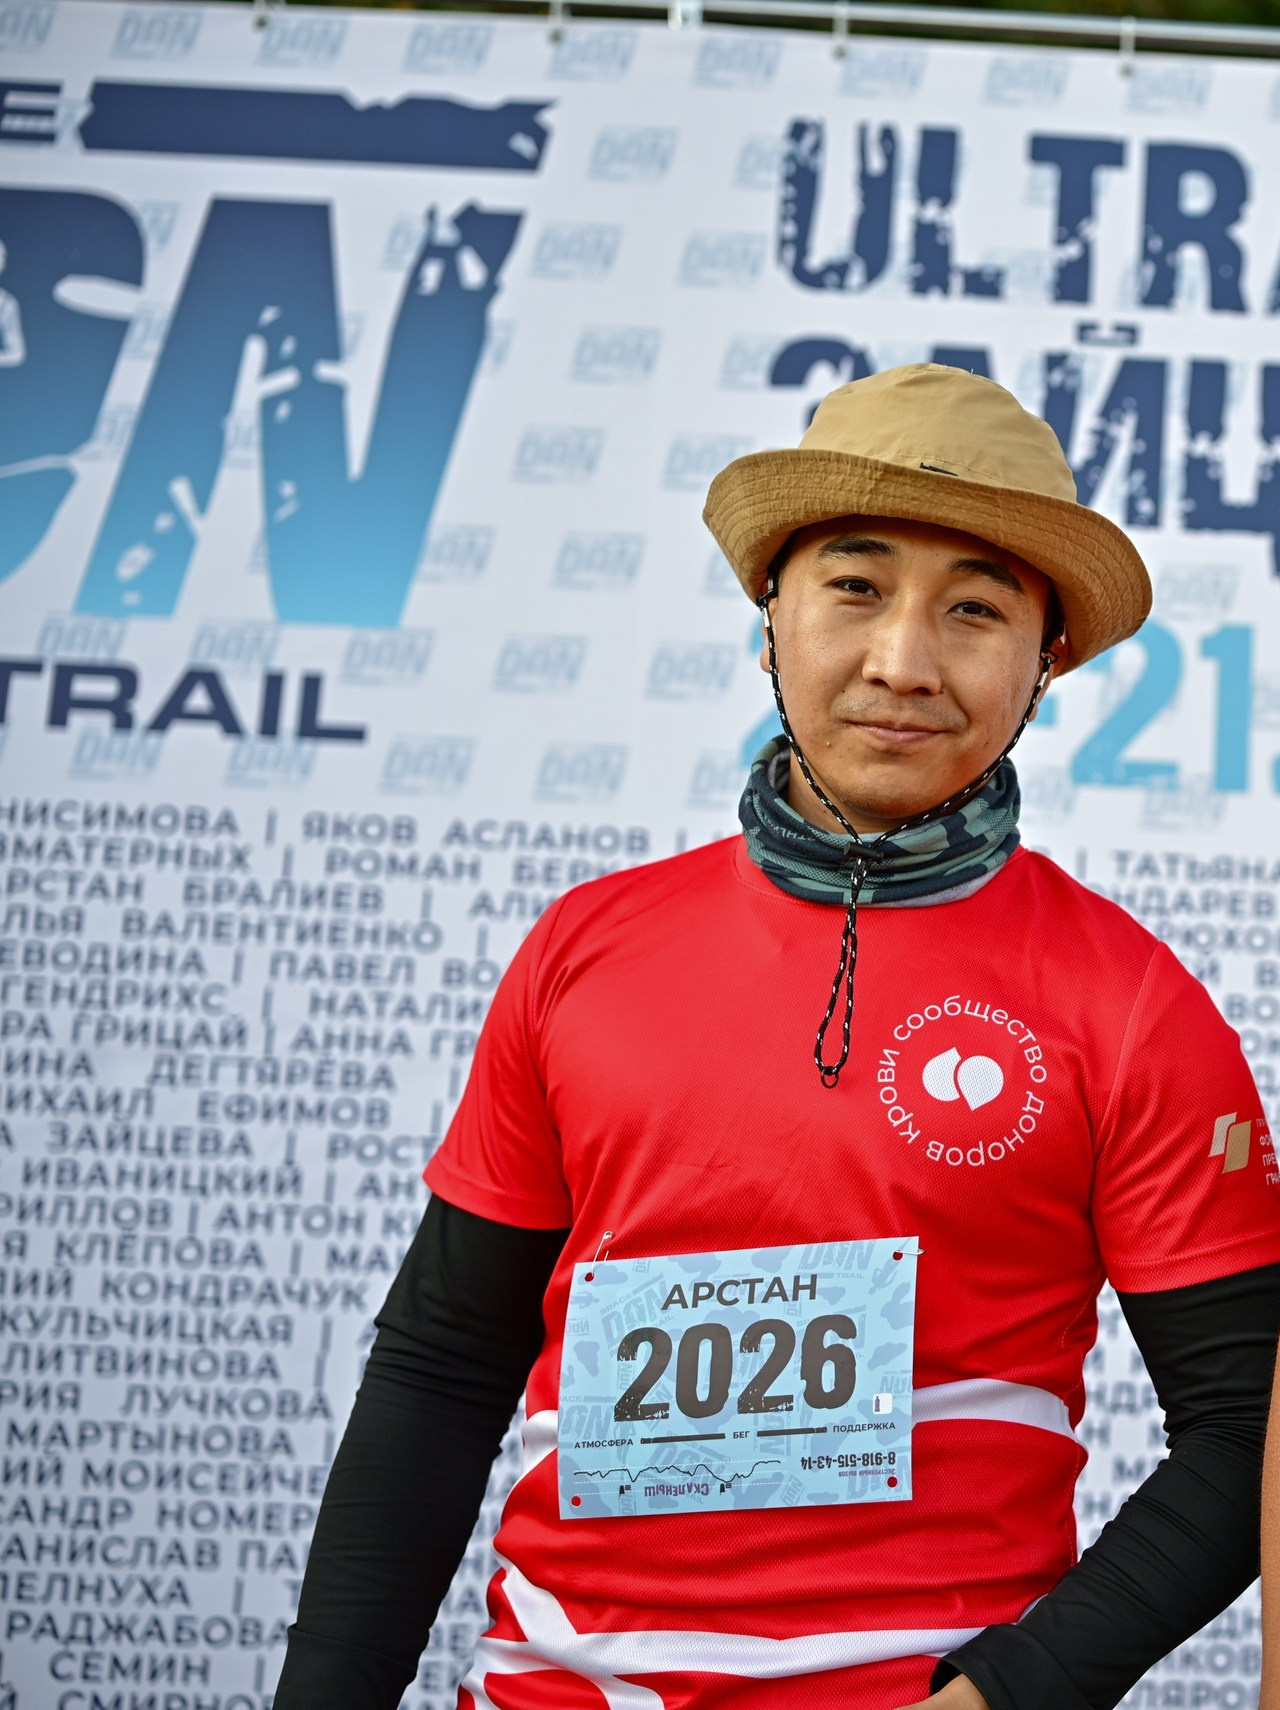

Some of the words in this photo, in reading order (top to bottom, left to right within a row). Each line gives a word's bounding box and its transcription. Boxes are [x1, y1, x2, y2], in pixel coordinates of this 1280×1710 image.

[301, 811, 417, 849] ЯКОВ
[441, 820, 650, 857] АСЛАНОВ
[325, 848, 482, 882] РОМАН
[183, 877, 385, 914] БРАЛИЕВ
[3, 903, 86, 938] ЛЬЯ
[122, 908, 443, 954] ВАЛЕНТИЕНКО
[269, 951, 416, 987] ПАВЕЛ
[1, 974, 229, 1016] ГЕНДРИХС
[71, 1012, 249, 1050] ГРИЦАЙ
[290, 1022, 414, 1057] АННА
[893, 994, 1048, 1084] сообщество
[4, 1046, 96, 1081] ИНА
[198, 1091, 391, 1132] ЕФИМОВ
[877, 1047, 922, 1145] крови
[46, 1115, 255, 1160] ЗАЙЦЕВА
[925, 1090, 1046, 1167] доноров
[22, 1155, 305, 1199] ИВАНИЦКИЙ
[213, 1201, 367, 1240] АНТОН
[54, 1227, 267, 1271] КЛЁПОВА
[0, 1262, 74, 1301] ИЙ
[101, 1271, 370, 1313] КОНДРАЧУК
[661, 1274, 818, 1311] АРСТАН
[2, 1342, 283, 1381] ЛИТВИНОВА
[613, 1313, 858, 1423] 2026
[119, 1384, 335, 1426] ЛУЧКОВА
[6, 1419, 297, 1460] МАРТЫНОВА
[574, 1438, 634, 1449] АТМОСФЕРА
[733, 1431, 750, 1440] БЕГ
[833, 1421, 896, 1433] ПОДДЕРЖКА
[800, 1451, 897, 1470] 8-918-515-43-14
[1, 1531, 221, 1572] АНИСЛАВ
[5, 1609, 290, 1651] РАДЖАБОВА
[49, 1650, 212, 1689] СЕМИН
